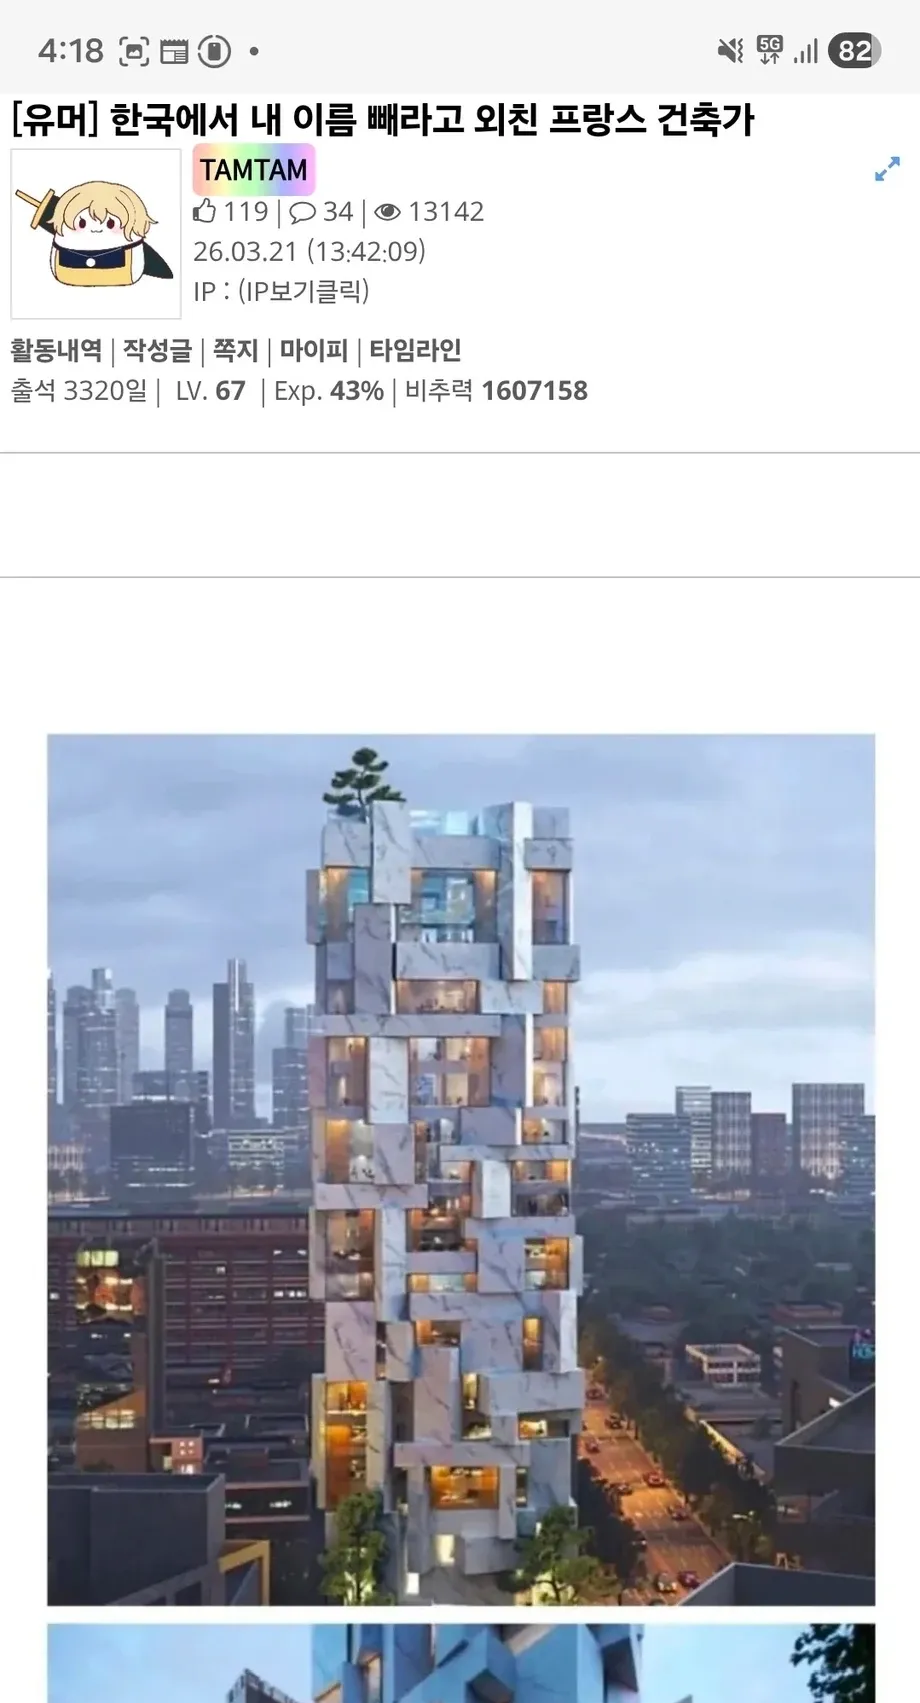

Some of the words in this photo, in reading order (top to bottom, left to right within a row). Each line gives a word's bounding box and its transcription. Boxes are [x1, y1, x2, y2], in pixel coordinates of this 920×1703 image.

[37, 37, 104, 64] 4:18
[759, 37, 781, 51] 5G
[838, 40, 872, 62] 82
[12, 99, 98, 138] [유머]
[109, 102, 238, 138] 한국에서
[251, 102, 282, 137] 내
[293, 102, 358, 138] 이름
[367, 102, 465, 138] 빼라고
[473, 102, 538, 138] 외친
[549, 102, 648, 138] 프랑스
[657, 101, 756, 138] 건축가
[199, 158, 308, 182] TAMTAM
[224, 200, 269, 222] 119
[323, 200, 354, 222] 34
[409, 200, 485, 222] 13142
[193, 240, 295, 262] 26.03.21
[307, 237, 425, 265] (13:42:09)
[194, 281, 216, 302] IP
[239, 277, 369, 305] (IP보기클릭)
[10, 337, 102, 364] 활동내역
[122, 337, 193, 364] 작성글
[213, 338, 258, 364] 쪽지
[280, 338, 348, 364] 마이피
[370, 337, 461, 363] 타임라인
[10, 377, 55, 404] 출석
[63, 378, 147, 403] 3320일
[177, 380, 208, 401] LV.
[215, 379, 246, 401] 67
[275, 380, 322, 407] Exp.
[329, 379, 385, 402] 43%
[406, 378, 472, 403] 비추력
[482, 379, 588, 401] 1607158
